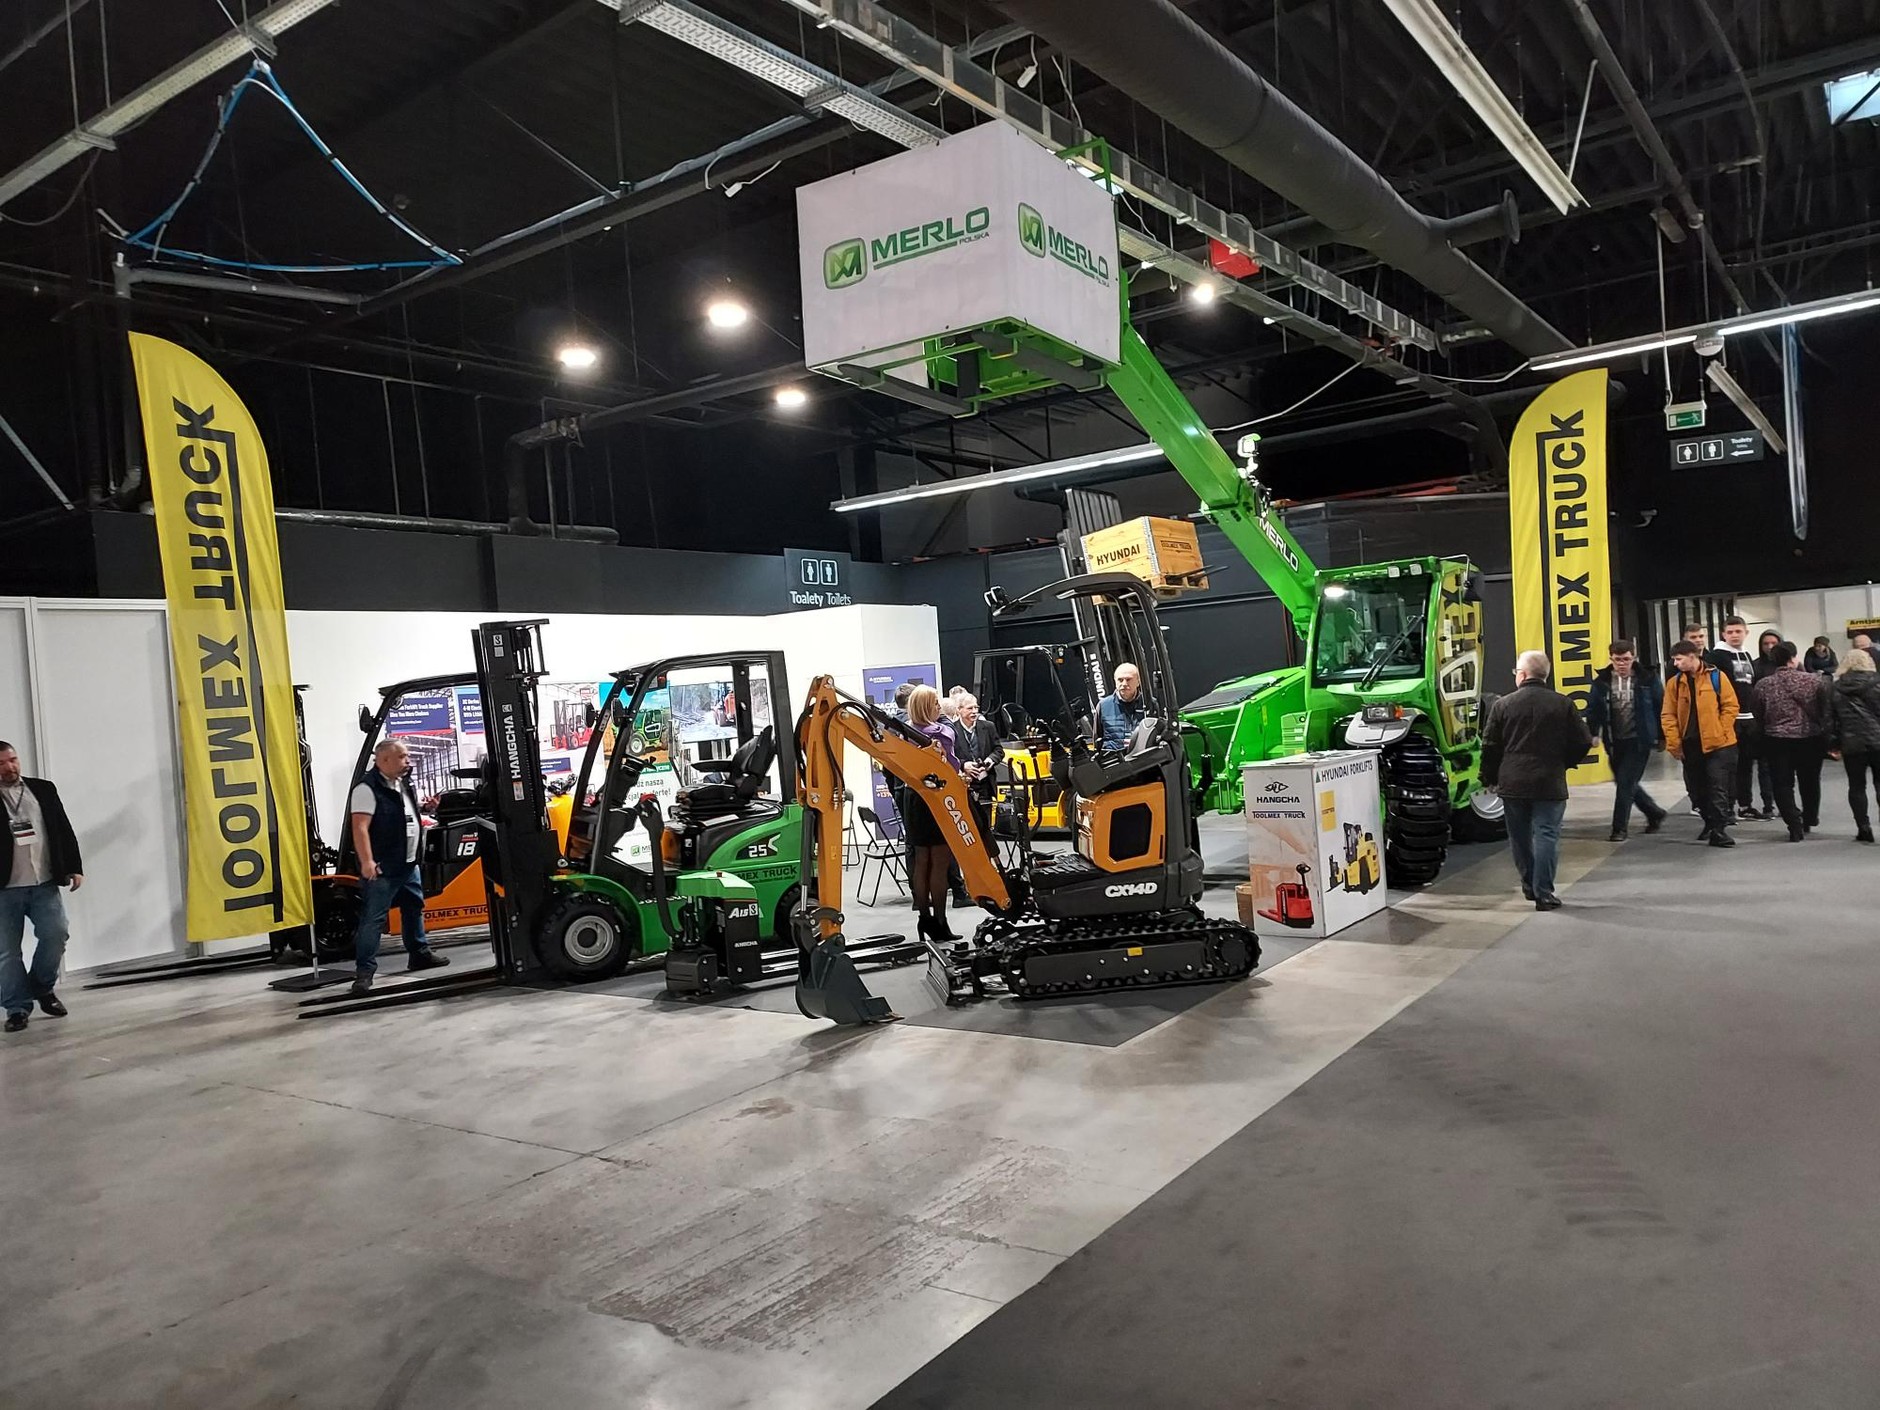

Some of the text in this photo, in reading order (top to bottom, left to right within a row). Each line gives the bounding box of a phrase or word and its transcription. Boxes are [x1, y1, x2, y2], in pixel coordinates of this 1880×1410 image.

[871, 206, 990, 262] MERLO
[959, 232, 990, 245] POLSKA
[1048, 225, 1109, 279] MERLO
[1550, 408, 1589, 557] TRUCK
[1260, 517, 1299, 572] MERLO
[1096, 543, 1141, 566] HYUNDAI
[789, 590, 852, 607] Toalety Toilets
[1090, 661, 1106, 700] UNDAI
[503, 715, 521, 779] HANGCHA
[1321, 760, 1373, 782] HYUNDAI FORKLIFTS
[1256, 796, 1300, 804] HANGCHA
[944, 796, 976, 847] CASE
[1252, 811, 1306, 819] TOOLMEX TRUCK
[457, 842, 477, 856] 18
[748, 844, 768, 858] 25
[765, 865, 798, 878] TRUCK
[1105, 882, 1157, 897] CX14D
[423, 909, 459, 919] OLMEX
[464, 906, 488, 915] TRUC
